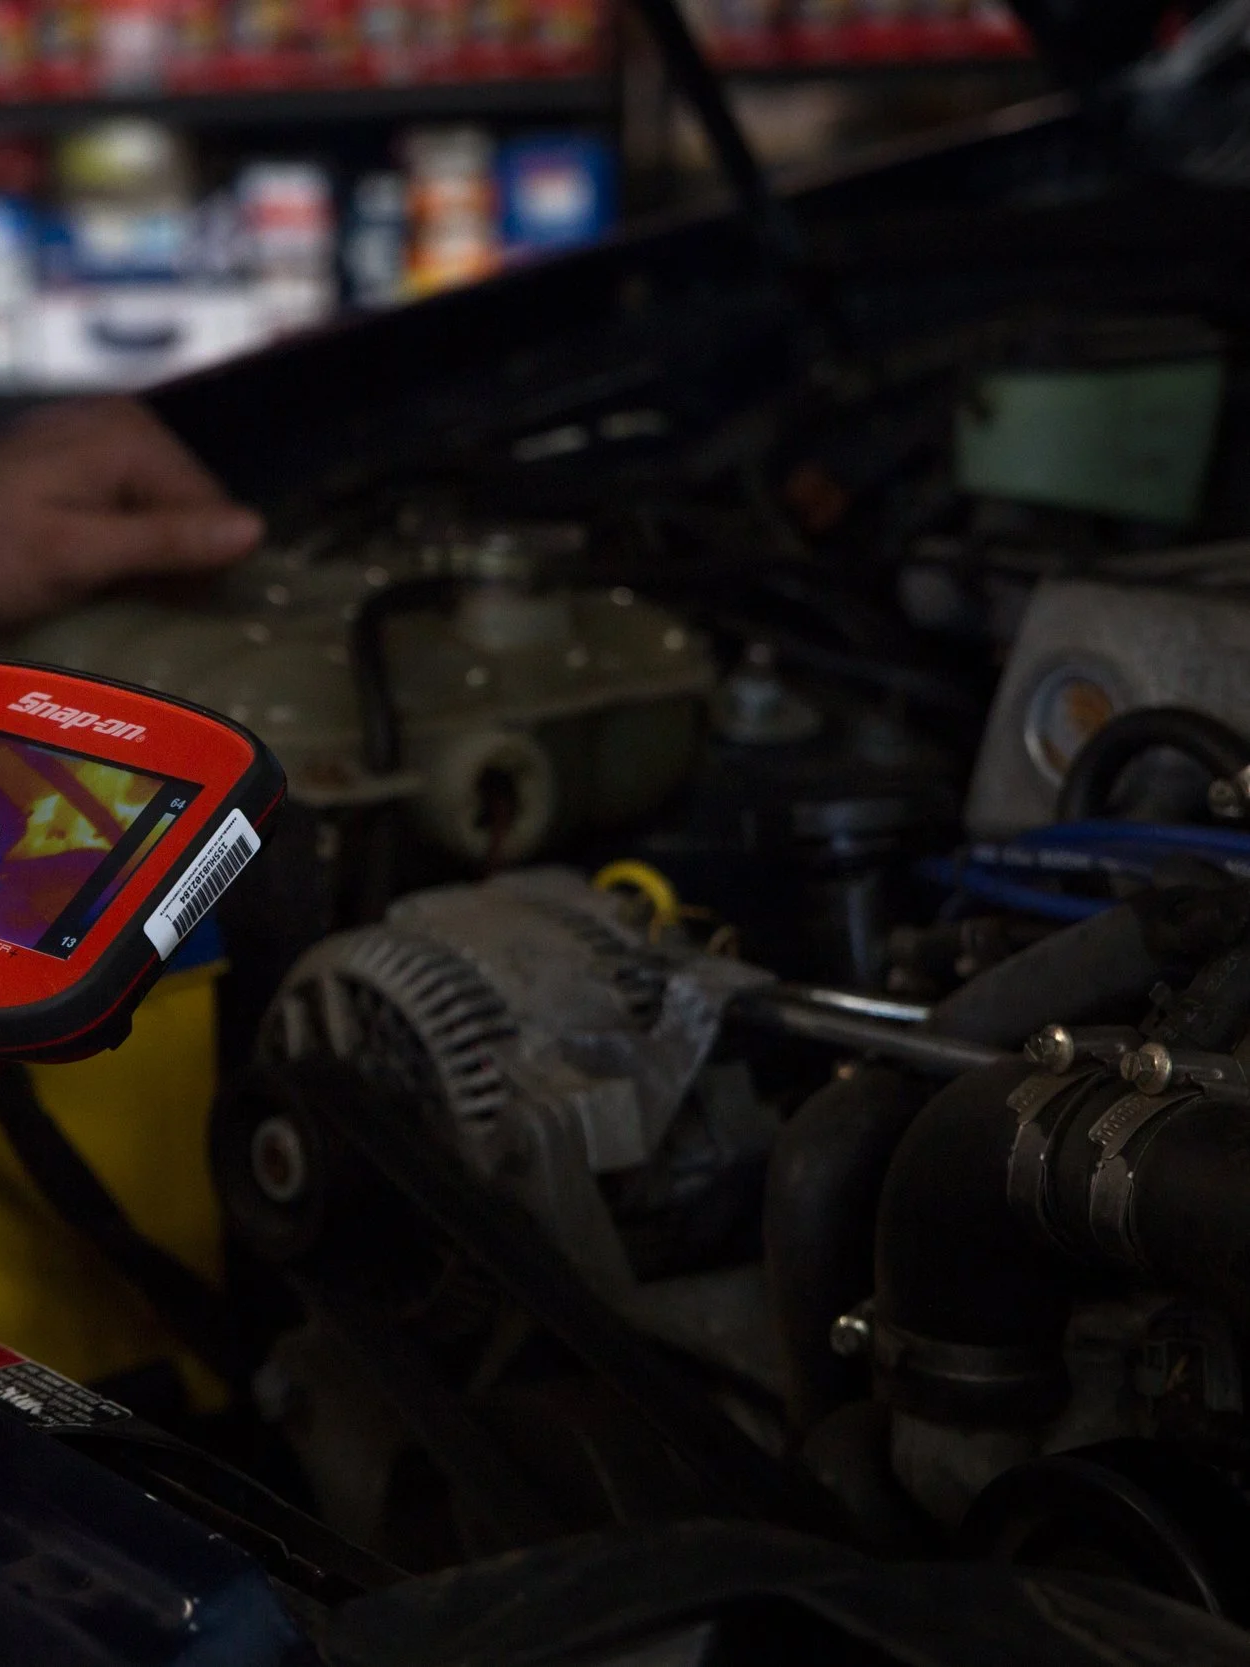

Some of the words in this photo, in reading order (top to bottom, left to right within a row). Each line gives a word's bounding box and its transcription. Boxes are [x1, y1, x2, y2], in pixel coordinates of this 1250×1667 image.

[170, 797, 187, 810] 64
[179, 841, 228, 904] 155HUB102184
[61, 936, 77, 948] 13
